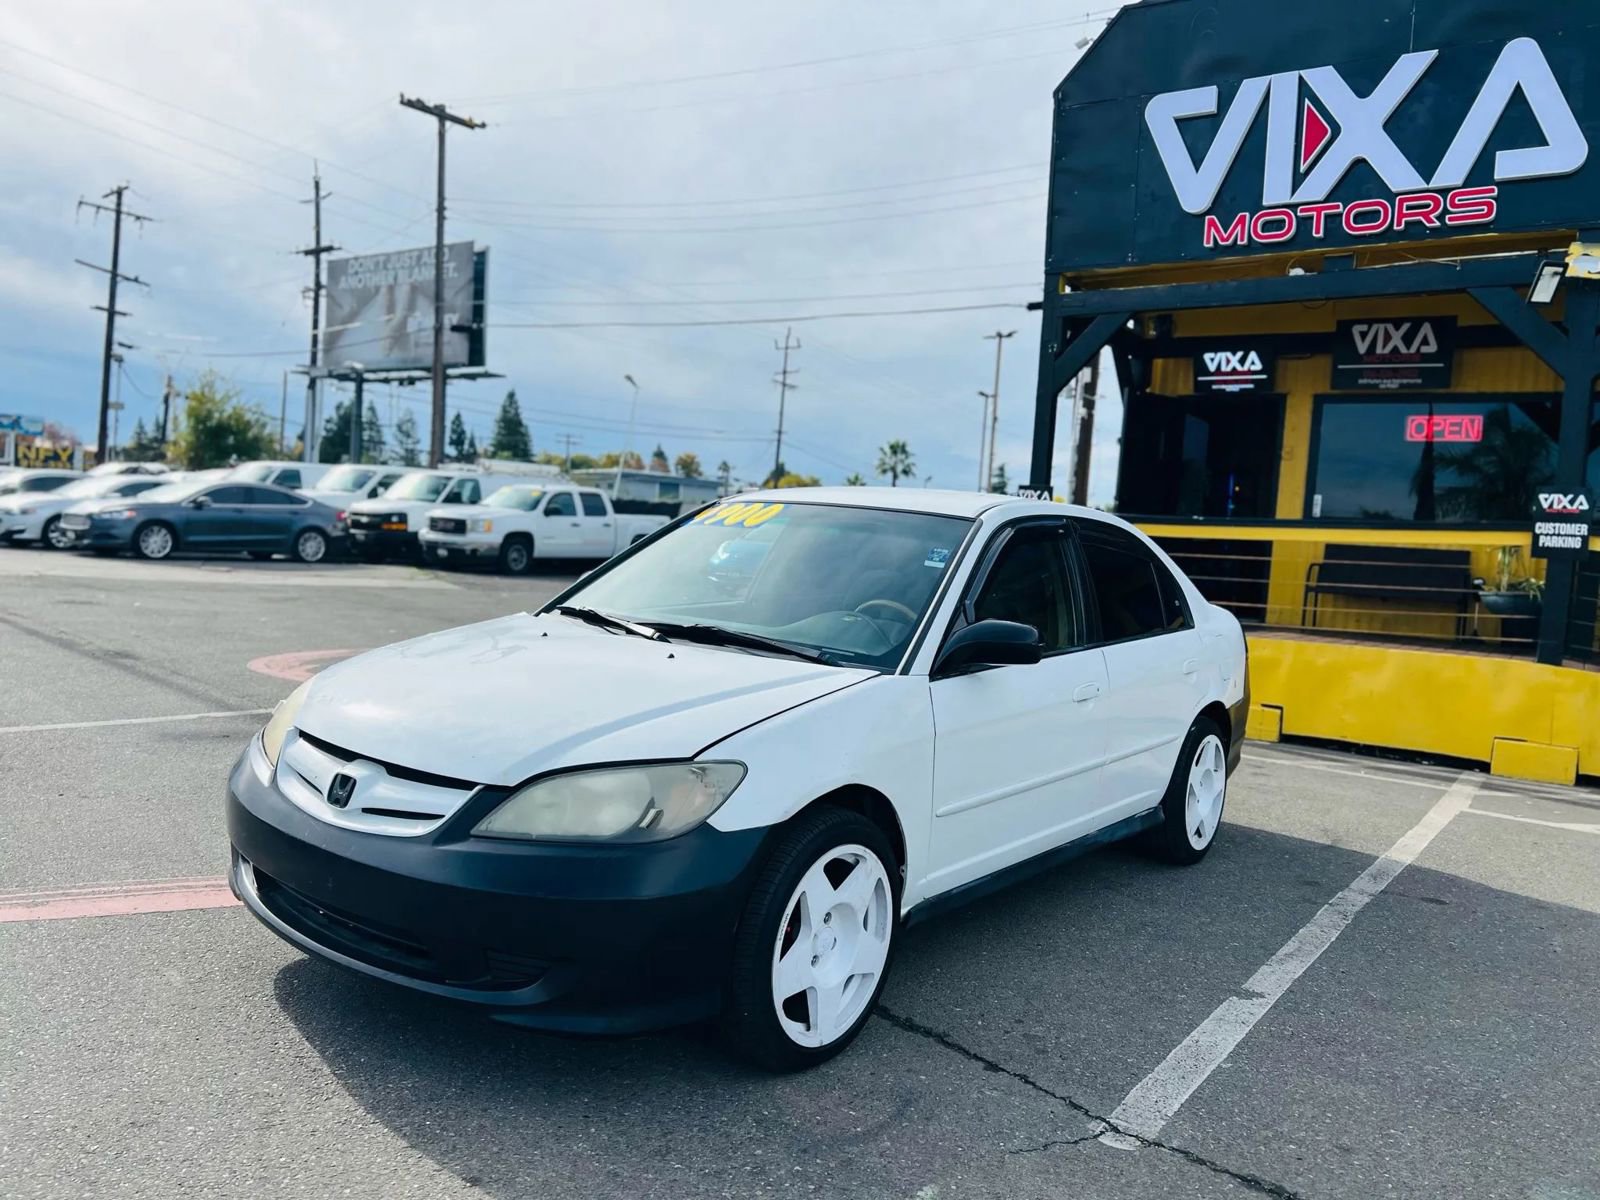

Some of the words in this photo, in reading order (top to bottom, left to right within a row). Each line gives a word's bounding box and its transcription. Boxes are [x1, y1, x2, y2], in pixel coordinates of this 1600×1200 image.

[1144, 37, 1589, 215] VIXA
[1203, 185, 1498, 249] MOTORS
[397, 262, 459, 284] BLANET.
[1352, 322, 1438, 355] VIXA
[1203, 351, 1263, 372] VIXA
[1410, 419, 1480, 440] OPEN
[1538, 493, 1590, 510] VIXA
[1535, 522, 1589, 536] CUSTOMER
[1539, 535, 1582, 549] PARKING
